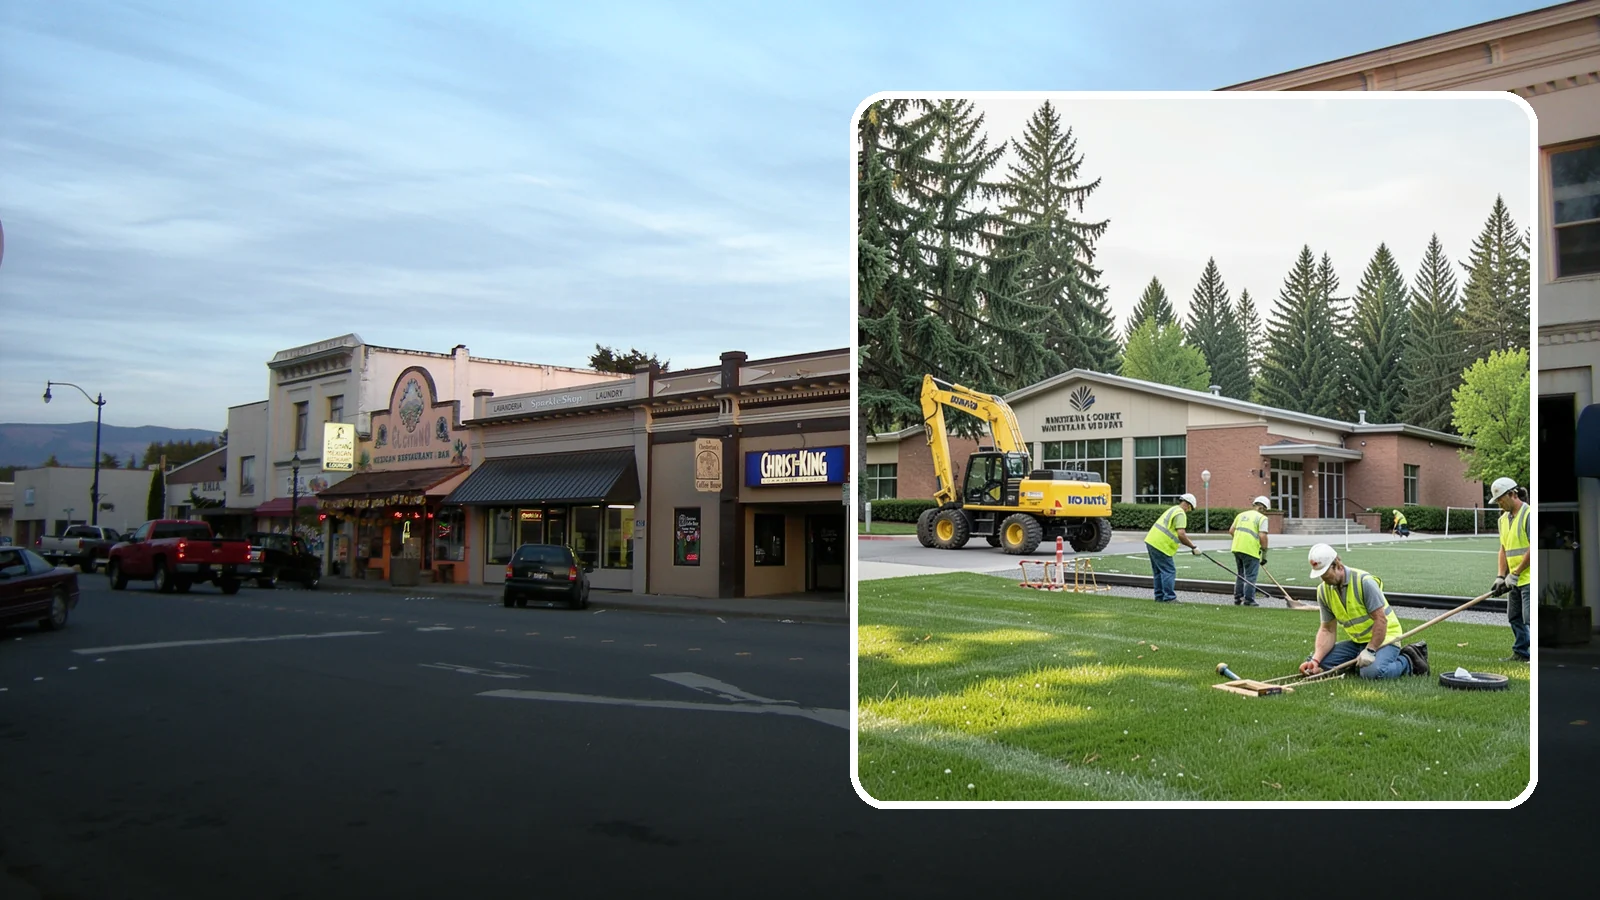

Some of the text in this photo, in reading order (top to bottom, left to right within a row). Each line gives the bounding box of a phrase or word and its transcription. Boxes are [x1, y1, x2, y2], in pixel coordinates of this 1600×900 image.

[596, 389, 624, 400] LAUNDRY
[494, 402, 523, 412] LAVANDERIA
[373, 455, 396, 464] MEXICAN
[397, 451, 433, 462] RESTAURANT
[438, 450, 450, 459] BAR
[761, 450, 827, 478] CHRIST KING
